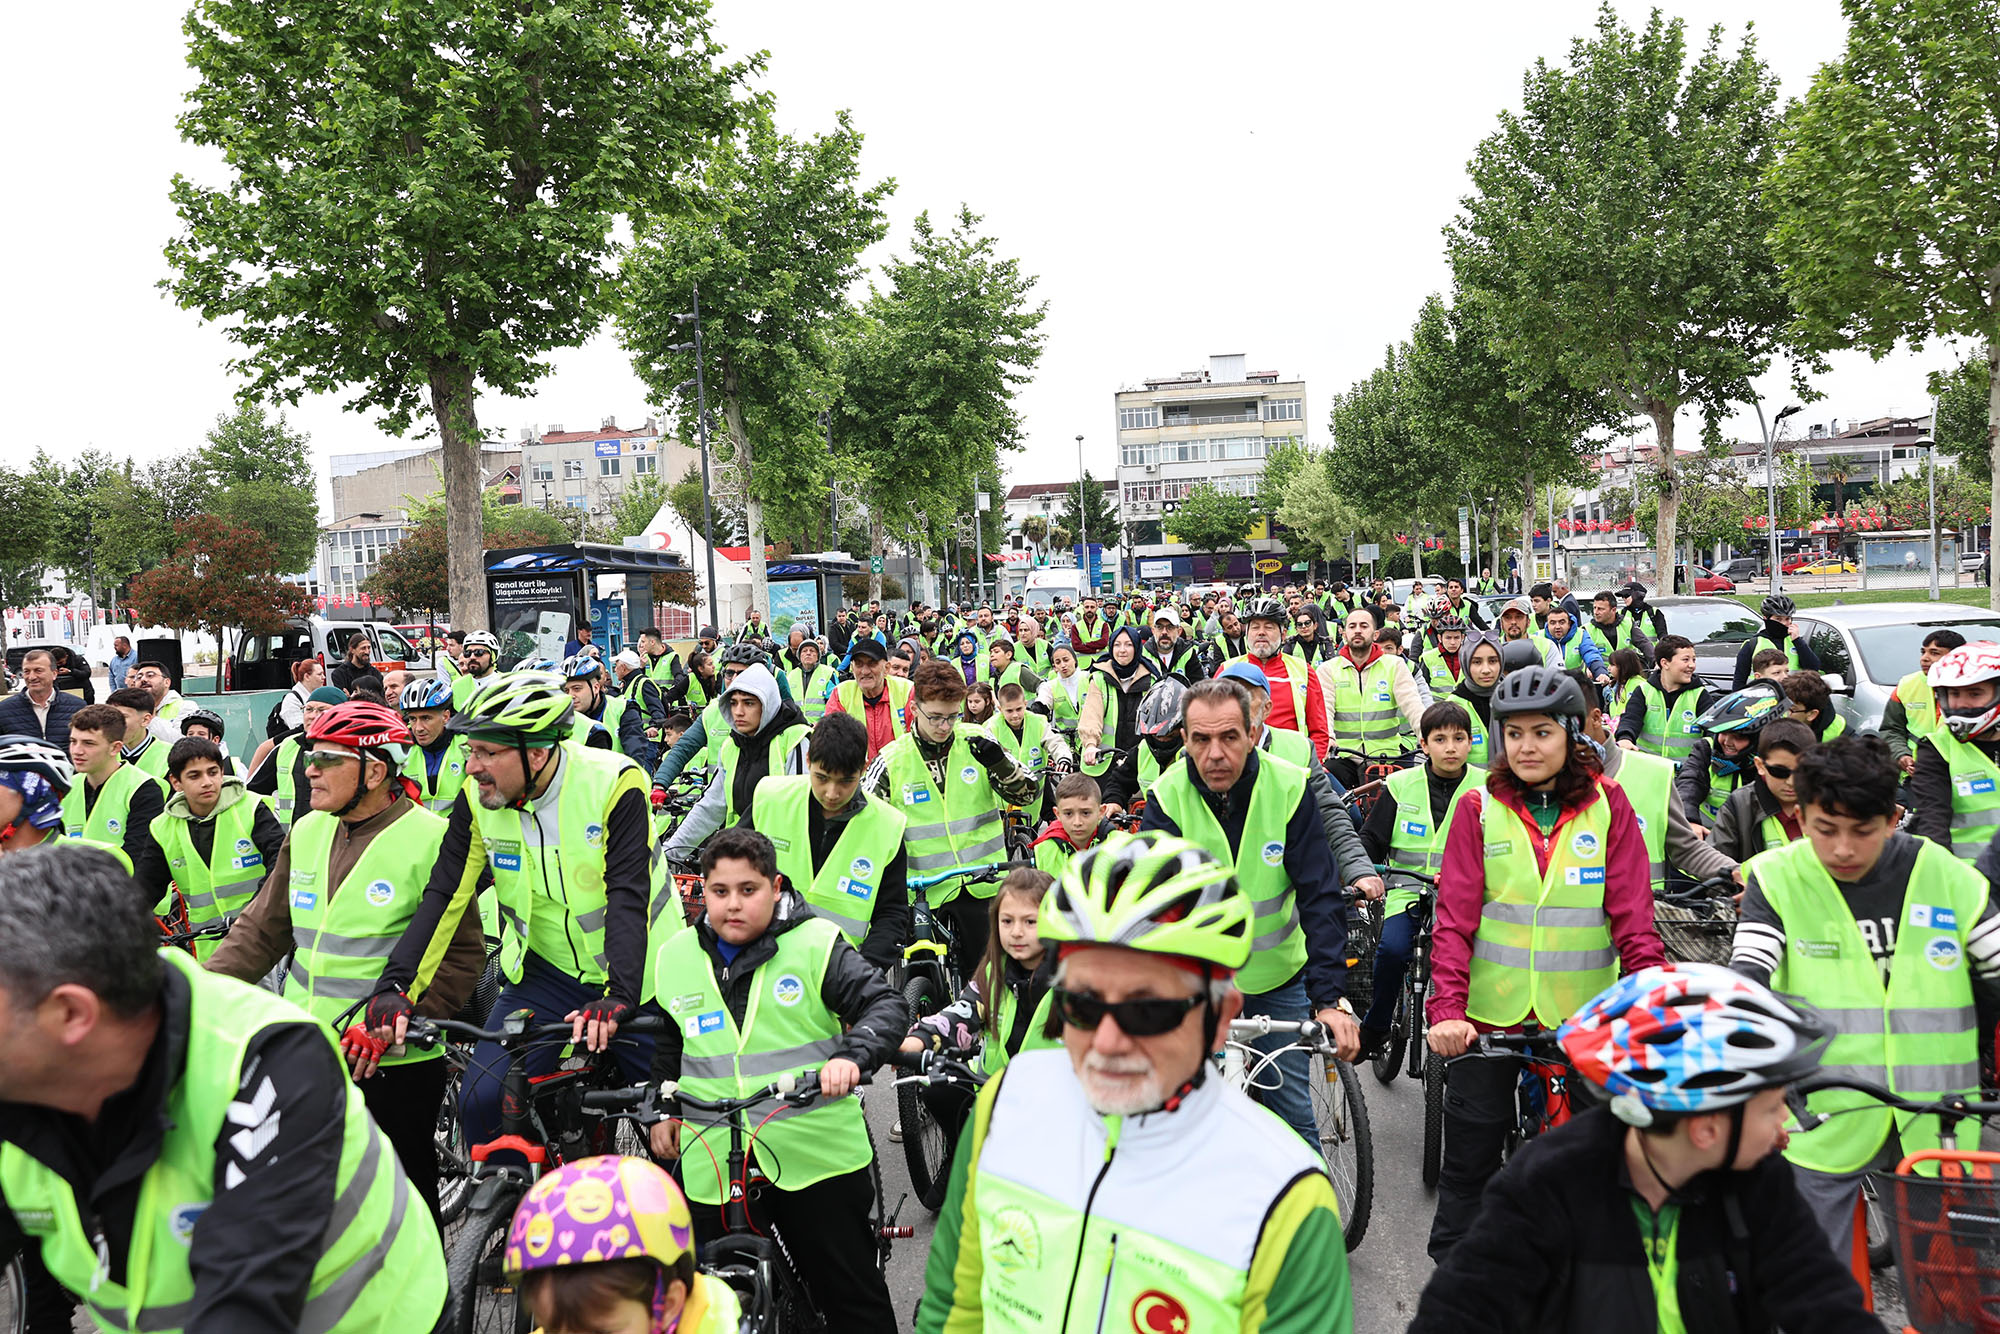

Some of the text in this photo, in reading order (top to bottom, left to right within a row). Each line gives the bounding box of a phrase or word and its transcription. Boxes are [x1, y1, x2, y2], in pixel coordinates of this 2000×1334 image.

[1258, 561, 1280, 569] gratis
[495, 581, 517, 589] Sanal
[519, 580, 535, 588] Kart
[495, 587, 563, 597] Ulaşımda Kolaylık!
[358, 732, 391, 746] KASK
